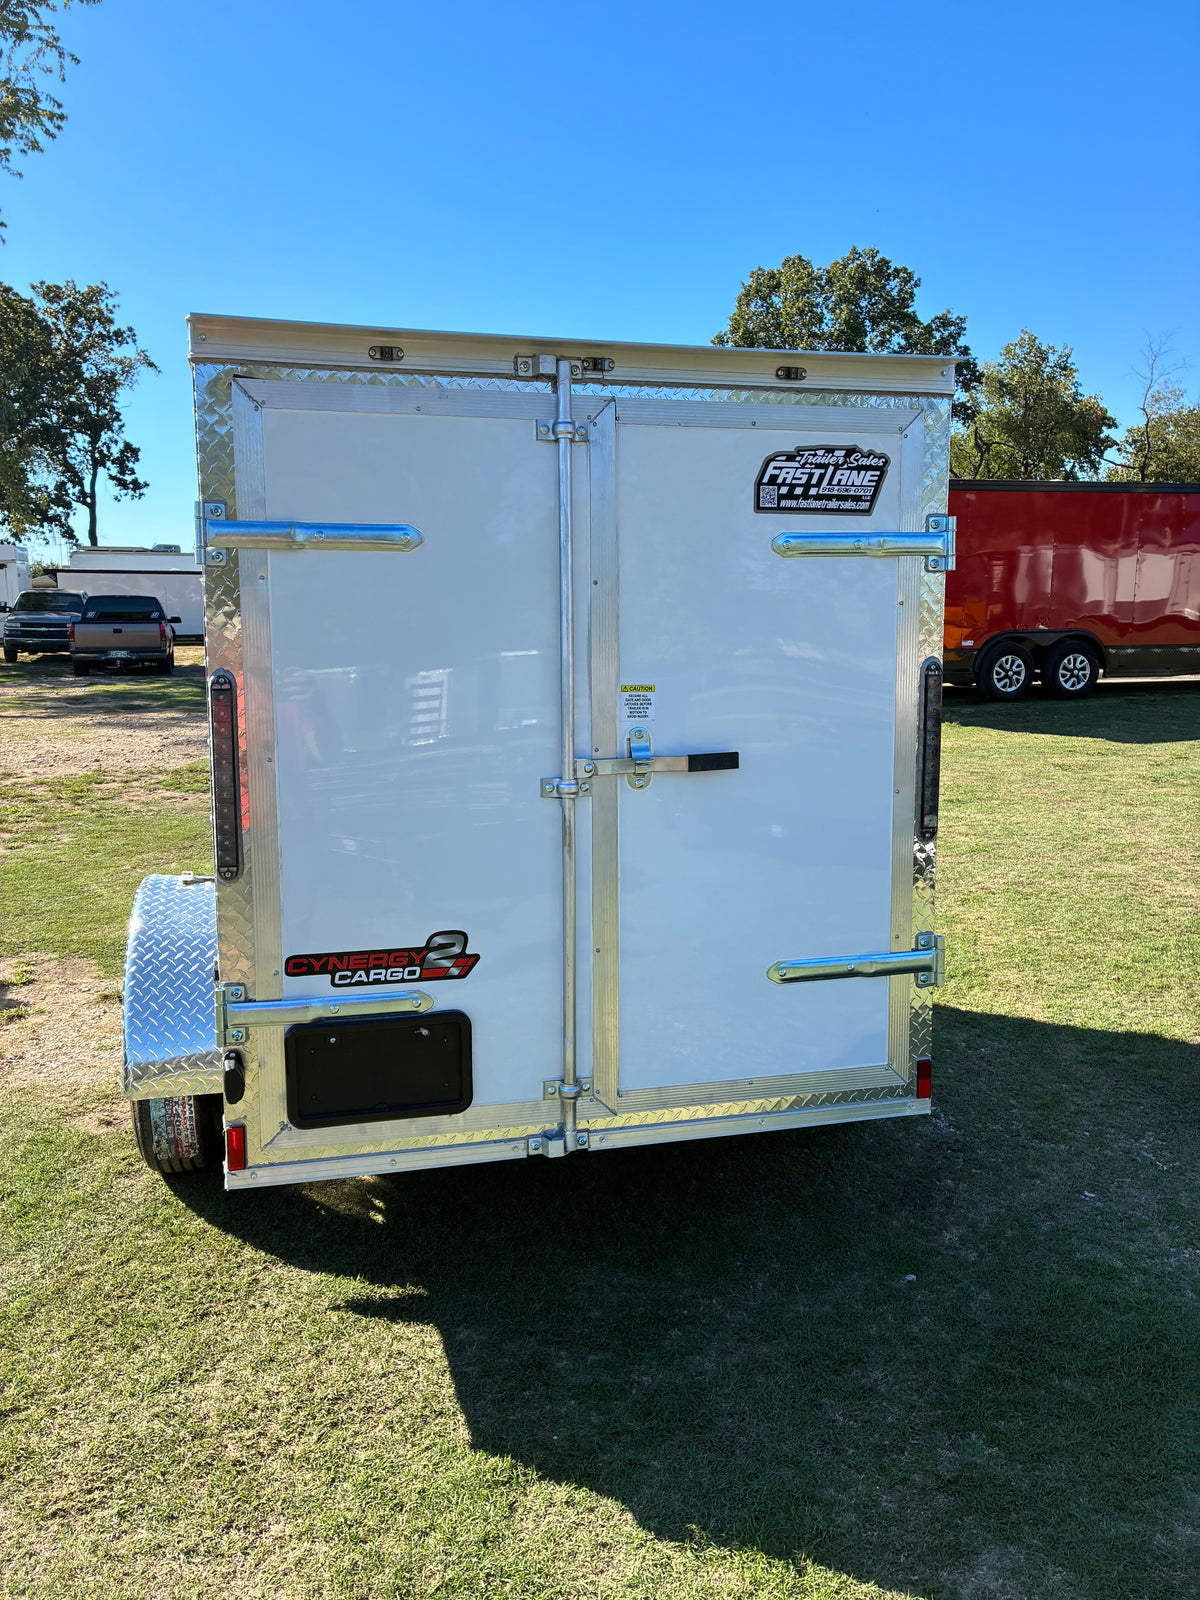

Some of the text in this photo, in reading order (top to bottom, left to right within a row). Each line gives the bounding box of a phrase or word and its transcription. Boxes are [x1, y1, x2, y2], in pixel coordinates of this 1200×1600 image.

[798, 450, 886, 467] Trailer Sales
[821, 486, 873, 494] 918-696-0701
[780, 498, 870, 510] www.fastlanetrailersales.com
[287, 933, 465, 974] CYNERGY 2
[334, 966, 421, 985] CARGO
[187, 1096, 197, 1155] AMERICAN
